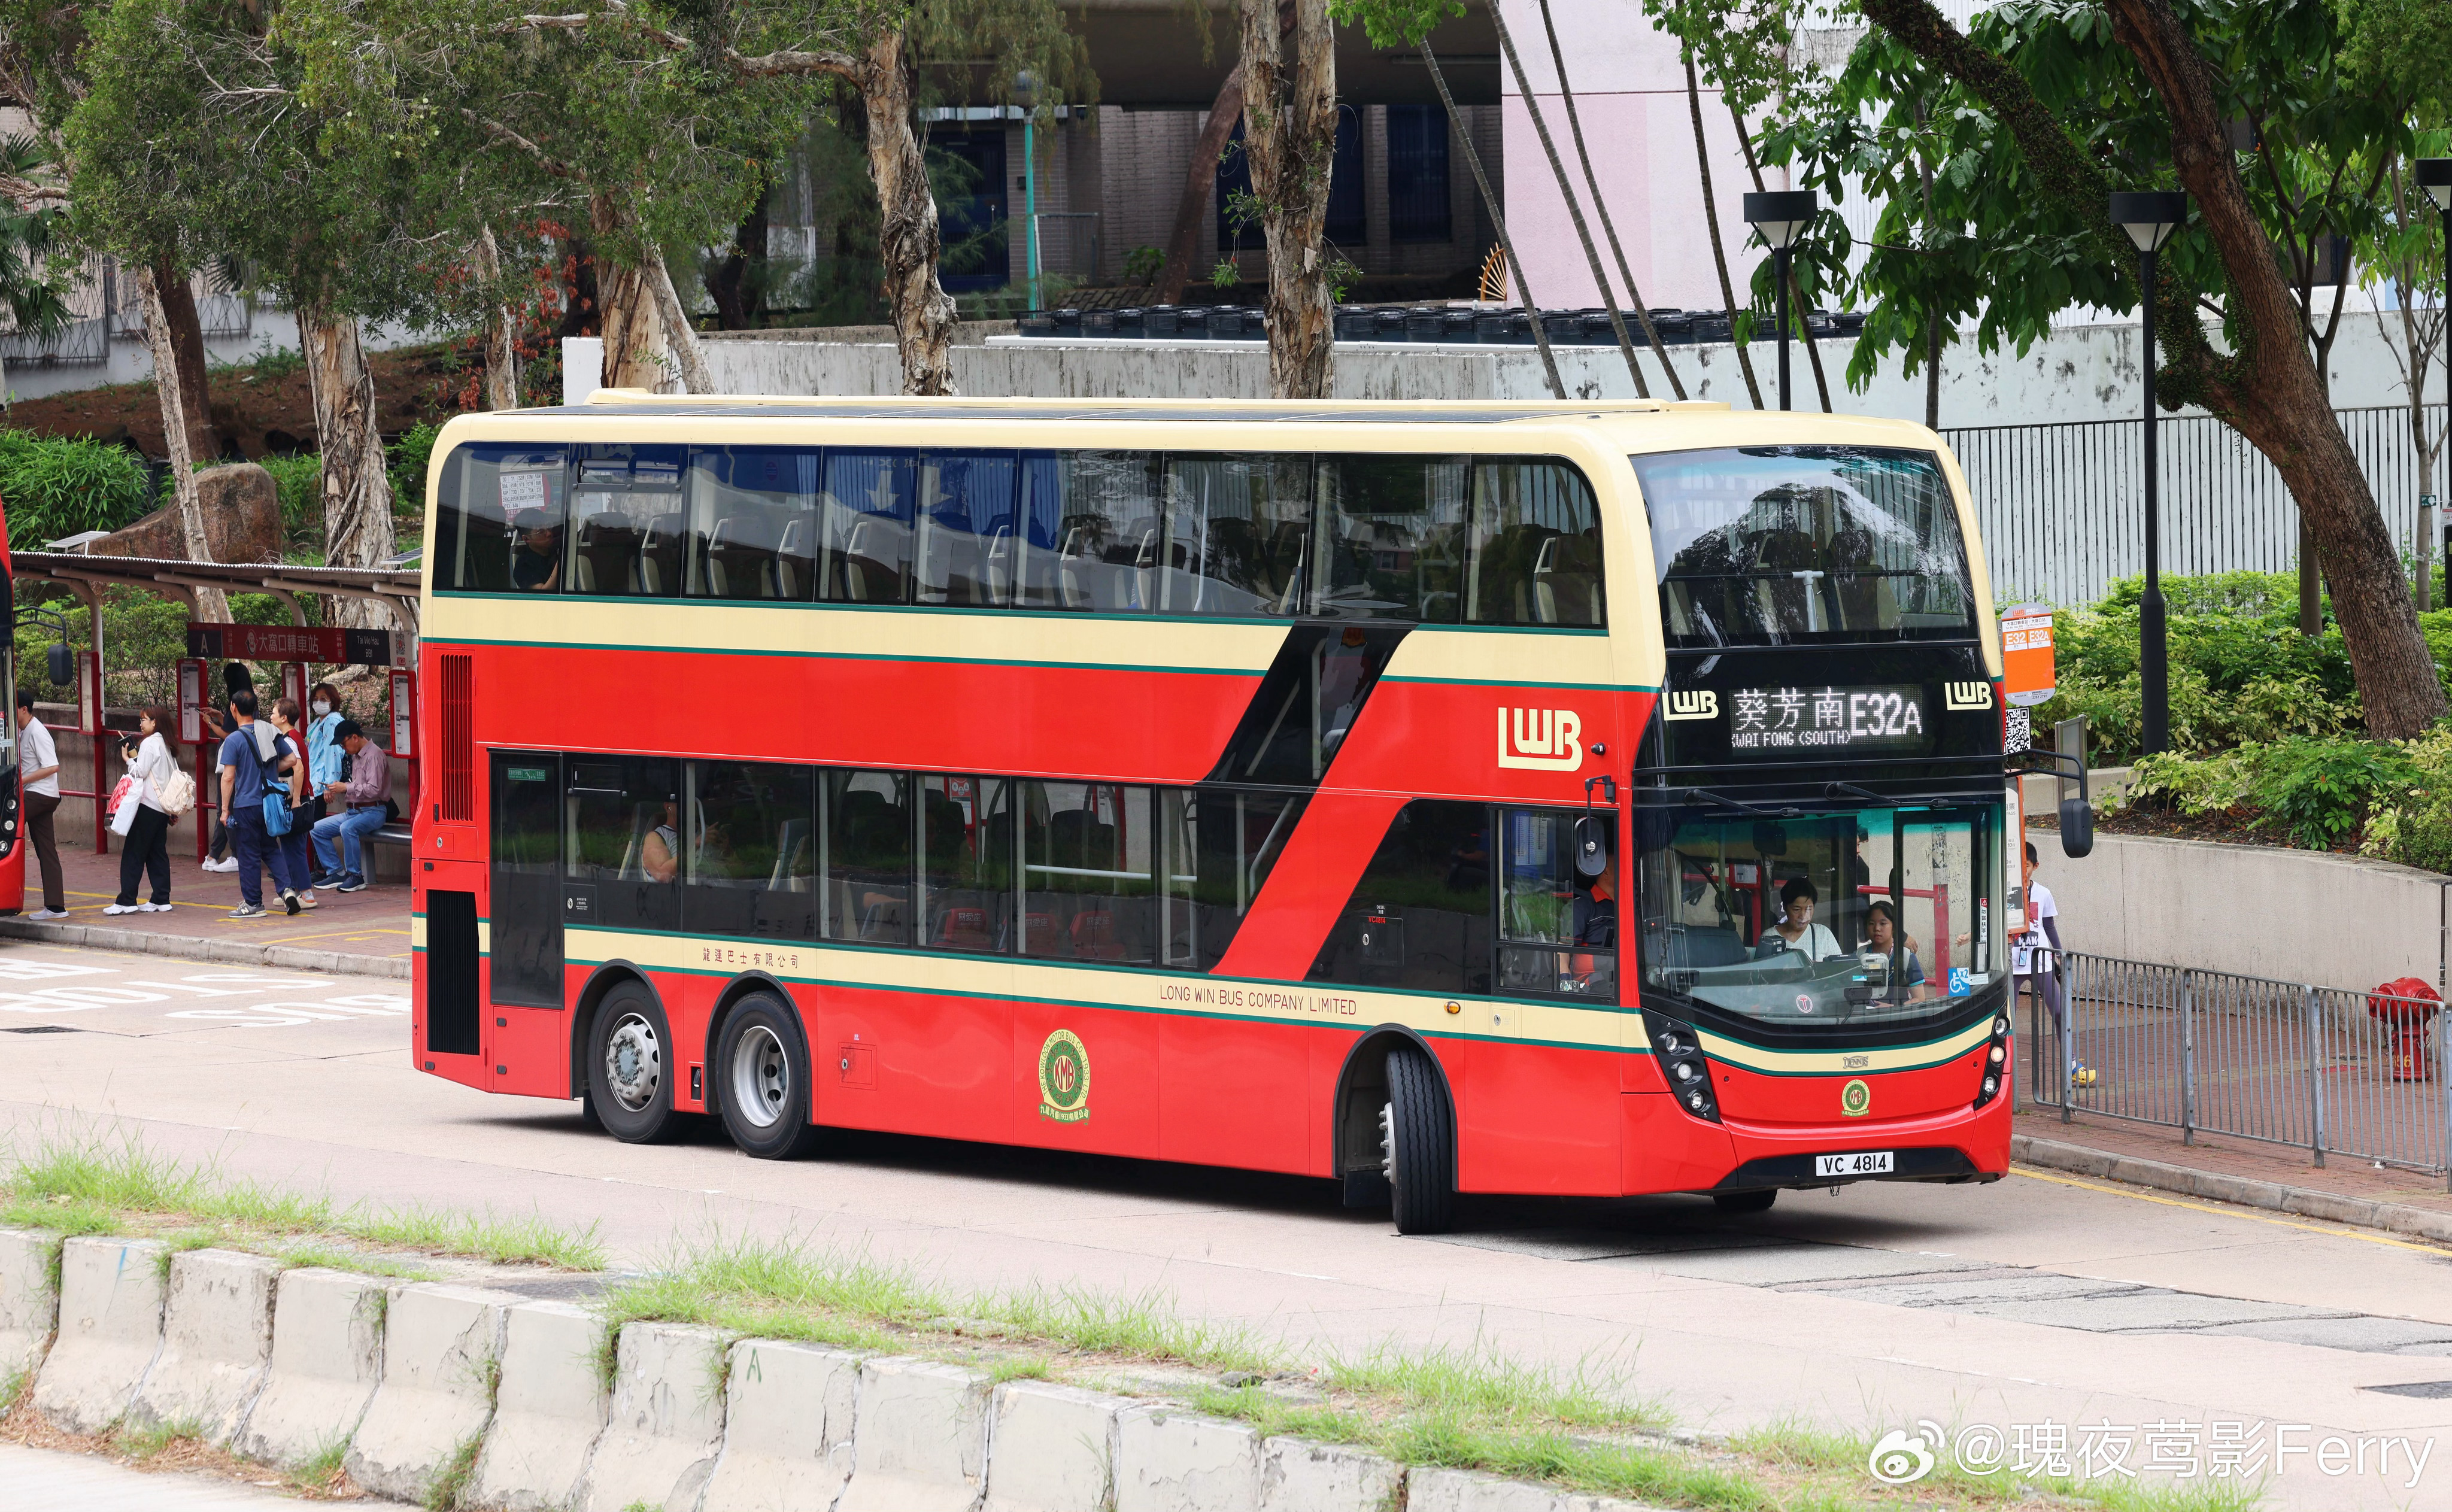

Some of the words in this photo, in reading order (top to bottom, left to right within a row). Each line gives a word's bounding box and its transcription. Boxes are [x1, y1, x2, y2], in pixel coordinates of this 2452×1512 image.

[201, 633, 208, 654] A
[259, 633, 318, 654] 大窩口轉車站
[364, 636, 371, 645] Wo
[371, 637, 380, 646] Hau
[2006, 632, 2026, 645] E32
[2029, 630, 2049, 642] E32A
[1661, 690, 1719, 721] LWB
[1944, 682, 1993, 711] LWB
[1734, 686, 1846, 730] 葵芳南
[1850, 693, 1922, 736] E32A
[1498, 707, 1583, 772] LWB
[1764, 732, 1794, 746] FONG
[1799, 730, 1852, 746] (SOUTH)
[703, 947, 798, 968] 龍運巴士有限公司
[1160, 985, 1190, 1001] LONG
[1194, 987, 1215, 1004] WIN
[1219, 989, 1243, 1007] BUS
[1249, 992, 1304, 1011] COMPANY
[1310, 996, 1357, 1015] LIMITED
[1040, 1043, 1051, 1079] KOWLOON
[1049, 1031, 1064, 1046] MOTOR
[1066, 1031, 1076, 1043] BUS
[1843, 1056, 1869, 1069] DENNIS
[1055, 1056, 1075, 1091] KMB
[1851, 1091, 1862, 1104] KMB
[1824, 1157, 1844, 1173] VC
[1852, 1154, 1887, 1171] 4814
